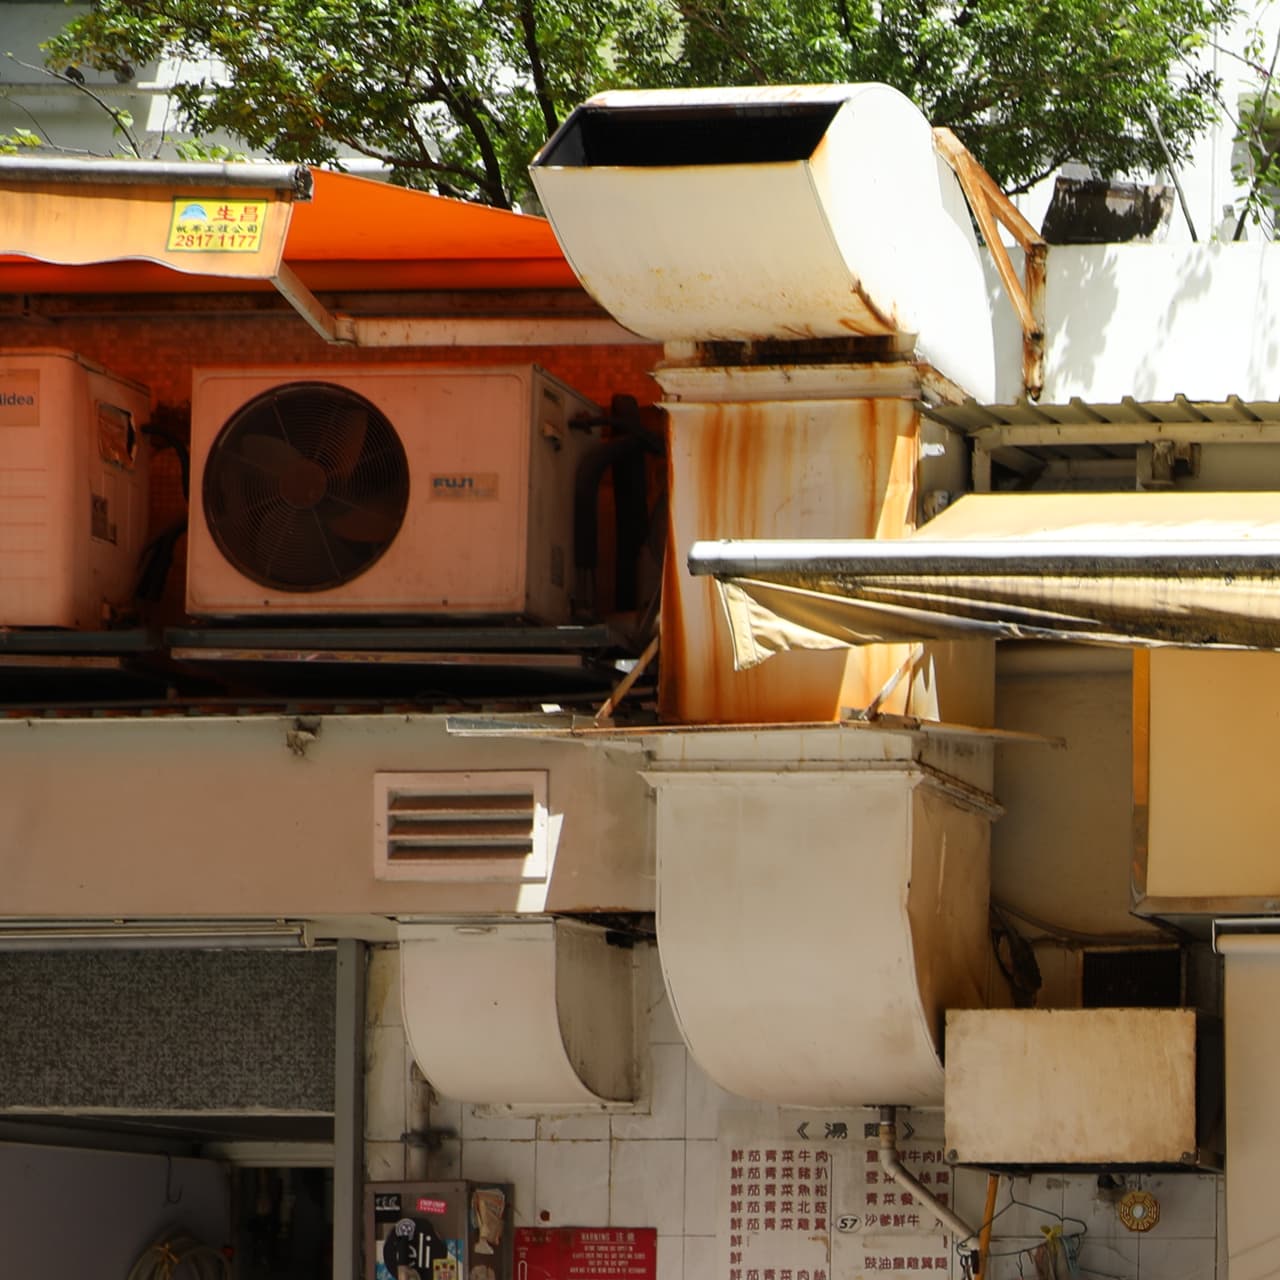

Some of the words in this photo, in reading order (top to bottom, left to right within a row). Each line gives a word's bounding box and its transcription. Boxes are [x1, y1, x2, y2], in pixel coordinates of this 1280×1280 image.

[213, 205, 258, 222] 生昌
[175, 234, 213, 248] 2817
[218, 234, 257, 248] 1177
[0, 393, 34, 406] idea
[731, 1150, 829, 1162] 鮮茄青菜牛肉
[731, 1167, 828, 1180] 鮮茄青菜豬扒
[730, 1201, 827, 1213] 鮮茄青菜北菇
[729, 1269, 826, 1280] 鮮茄青菜肉絲
